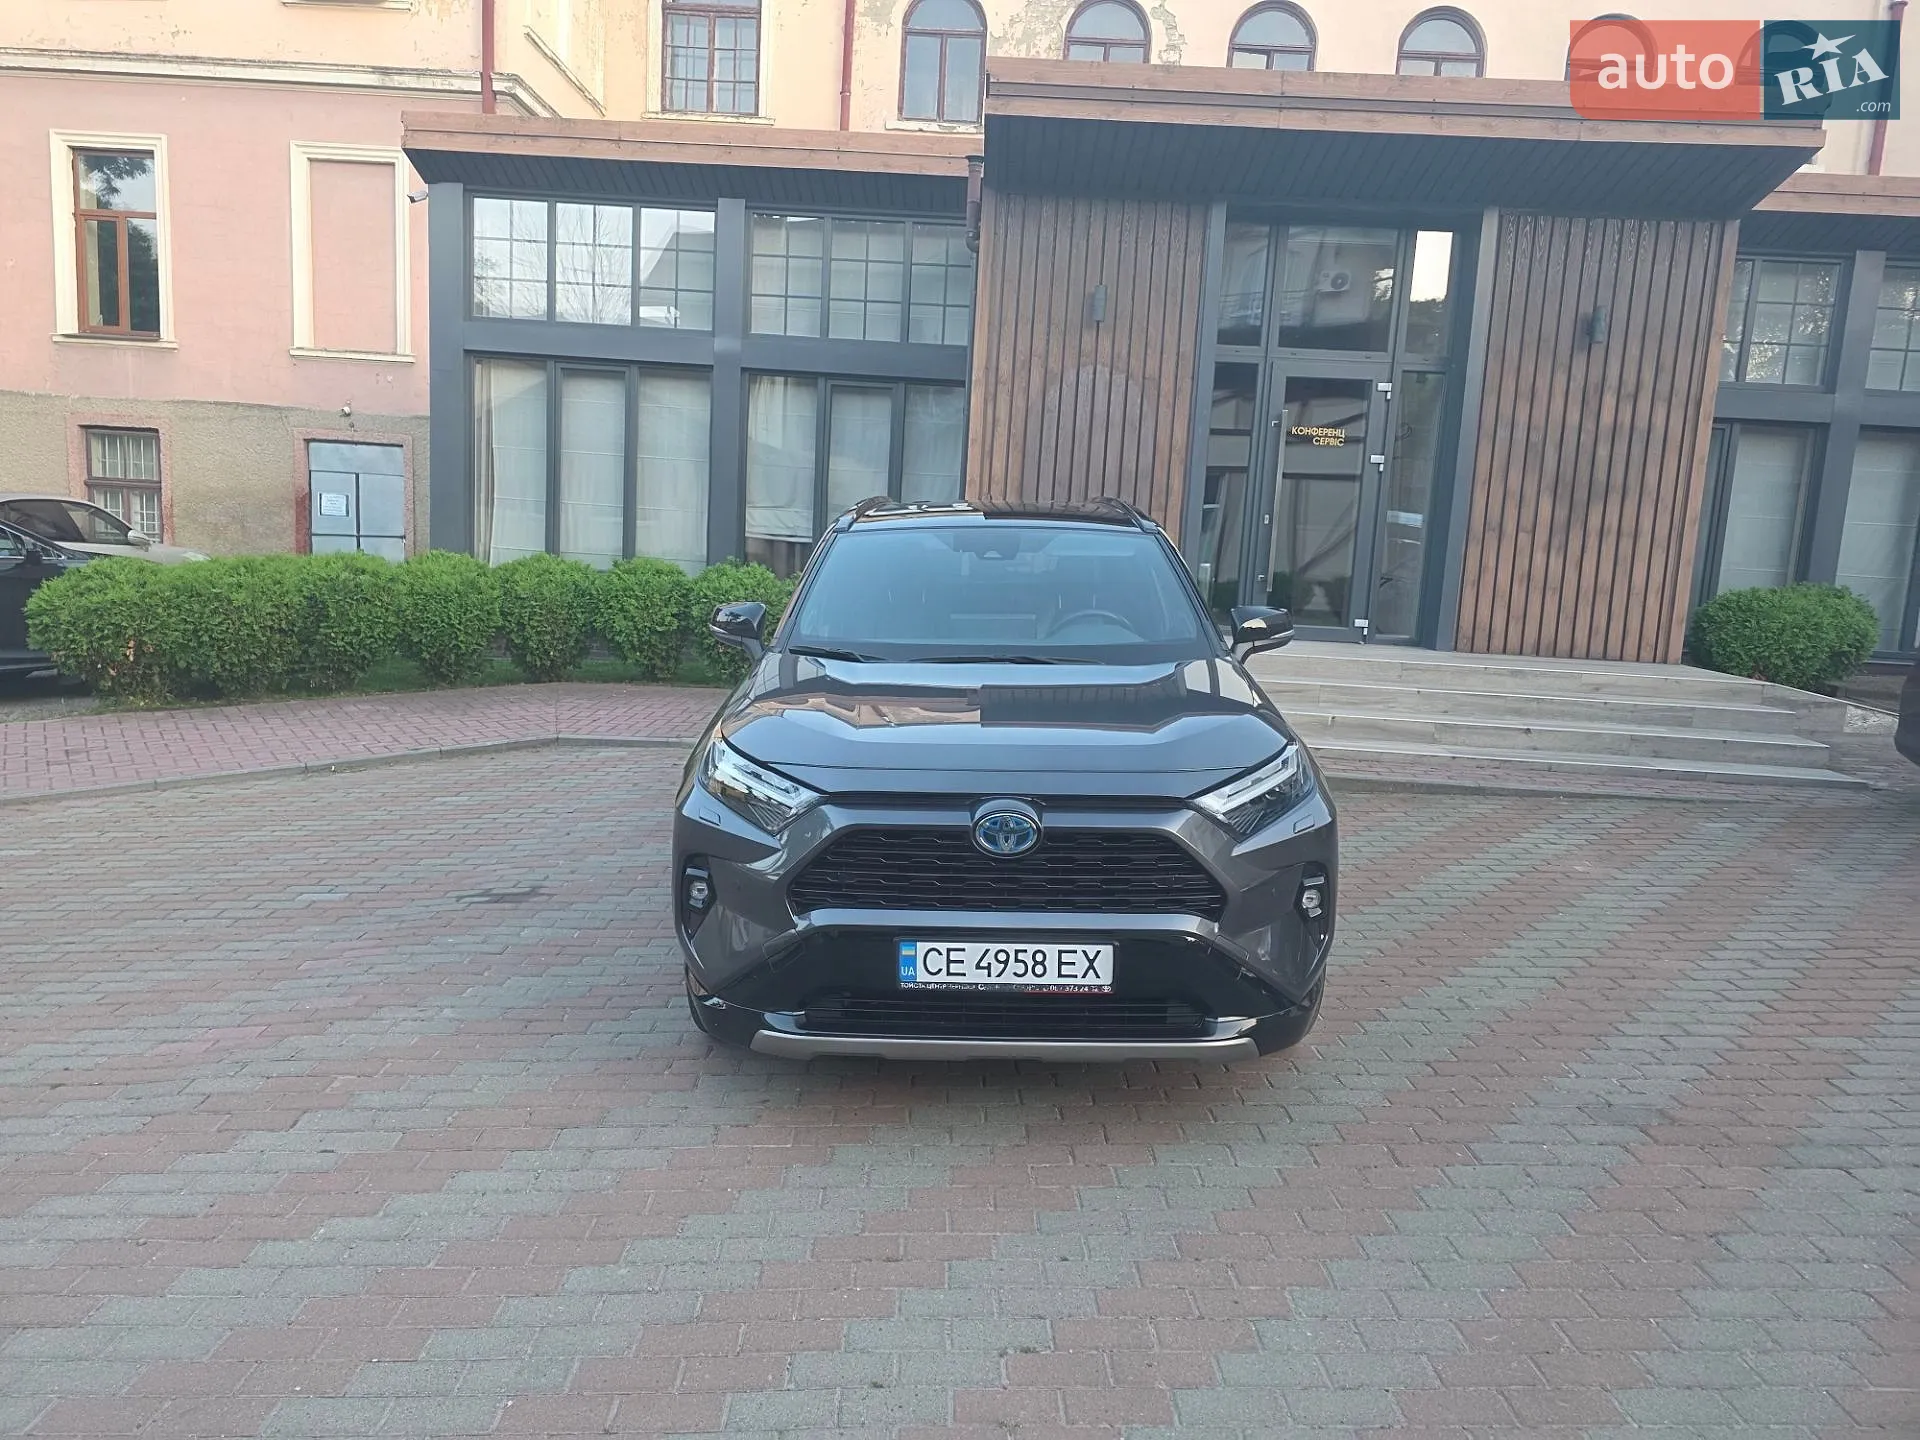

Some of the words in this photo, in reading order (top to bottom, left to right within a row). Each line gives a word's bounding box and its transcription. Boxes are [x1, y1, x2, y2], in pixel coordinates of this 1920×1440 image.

[1291, 426, 1345, 438] КОНФЕРЕНЦ
[1313, 437, 1345, 447] СЕРВІС
[923, 947, 966, 977] CE
[975, 948, 1047, 978] 4958
[1057, 949, 1102, 979] EX
[901, 966, 915, 976] UA
